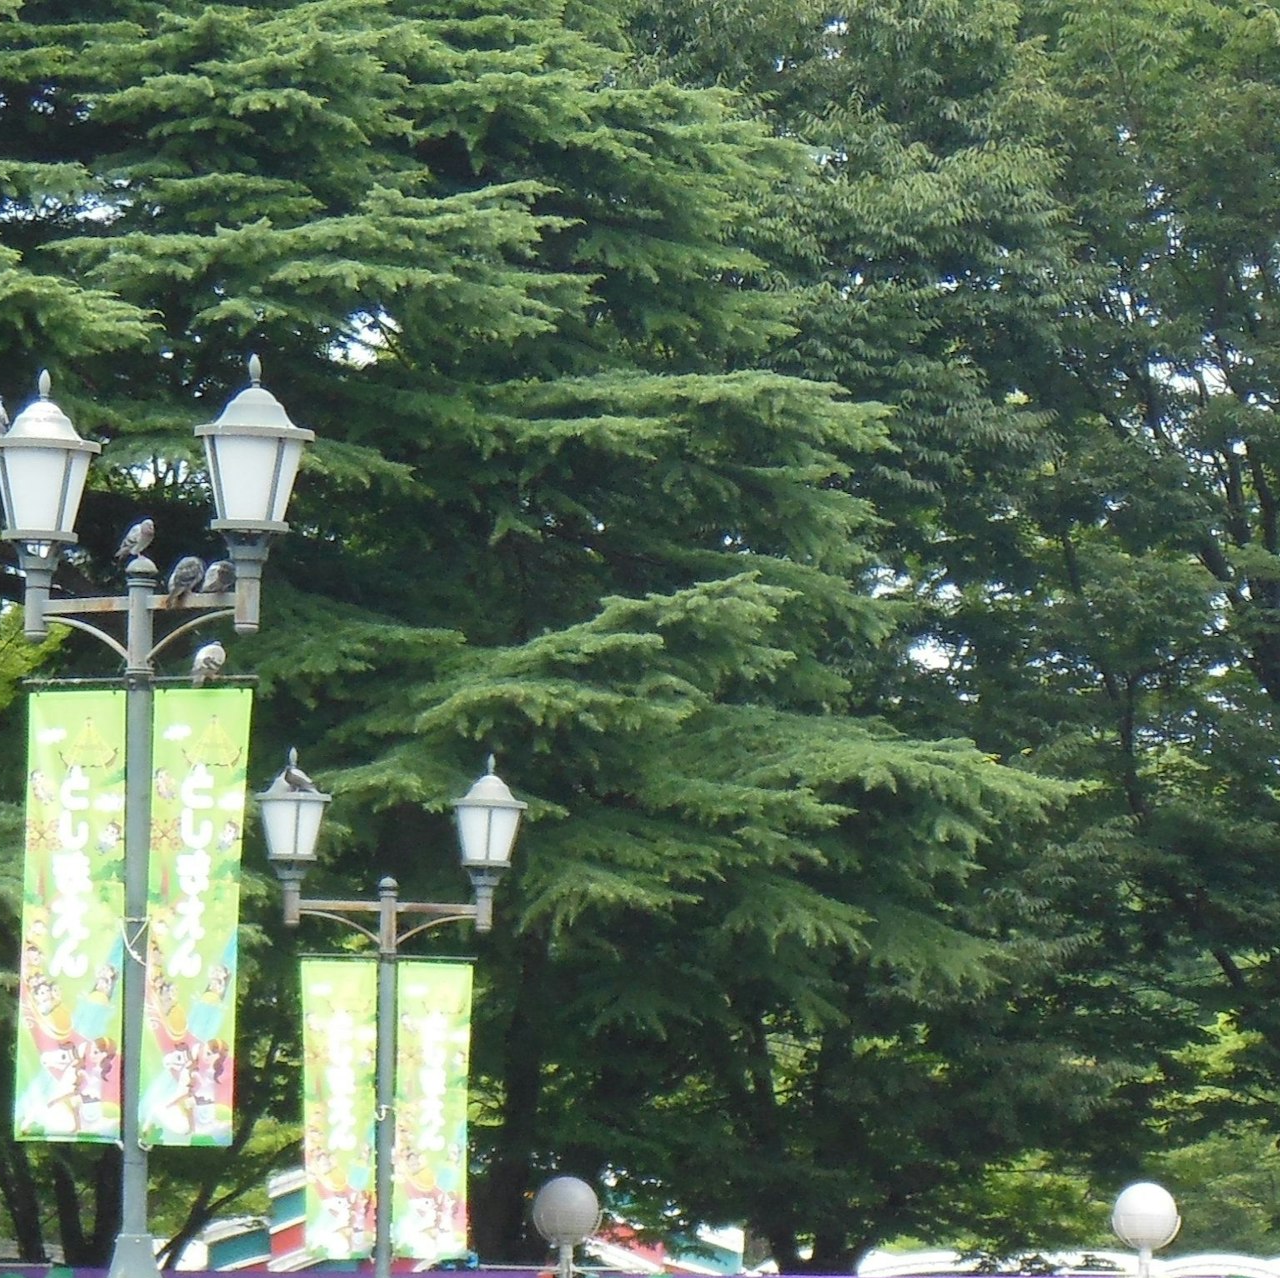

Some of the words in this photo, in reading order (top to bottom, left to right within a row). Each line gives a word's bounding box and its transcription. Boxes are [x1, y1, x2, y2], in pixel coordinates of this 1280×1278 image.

[49, 764, 93, 978] としまえん
[167, 763, 214, 978] としまえん
